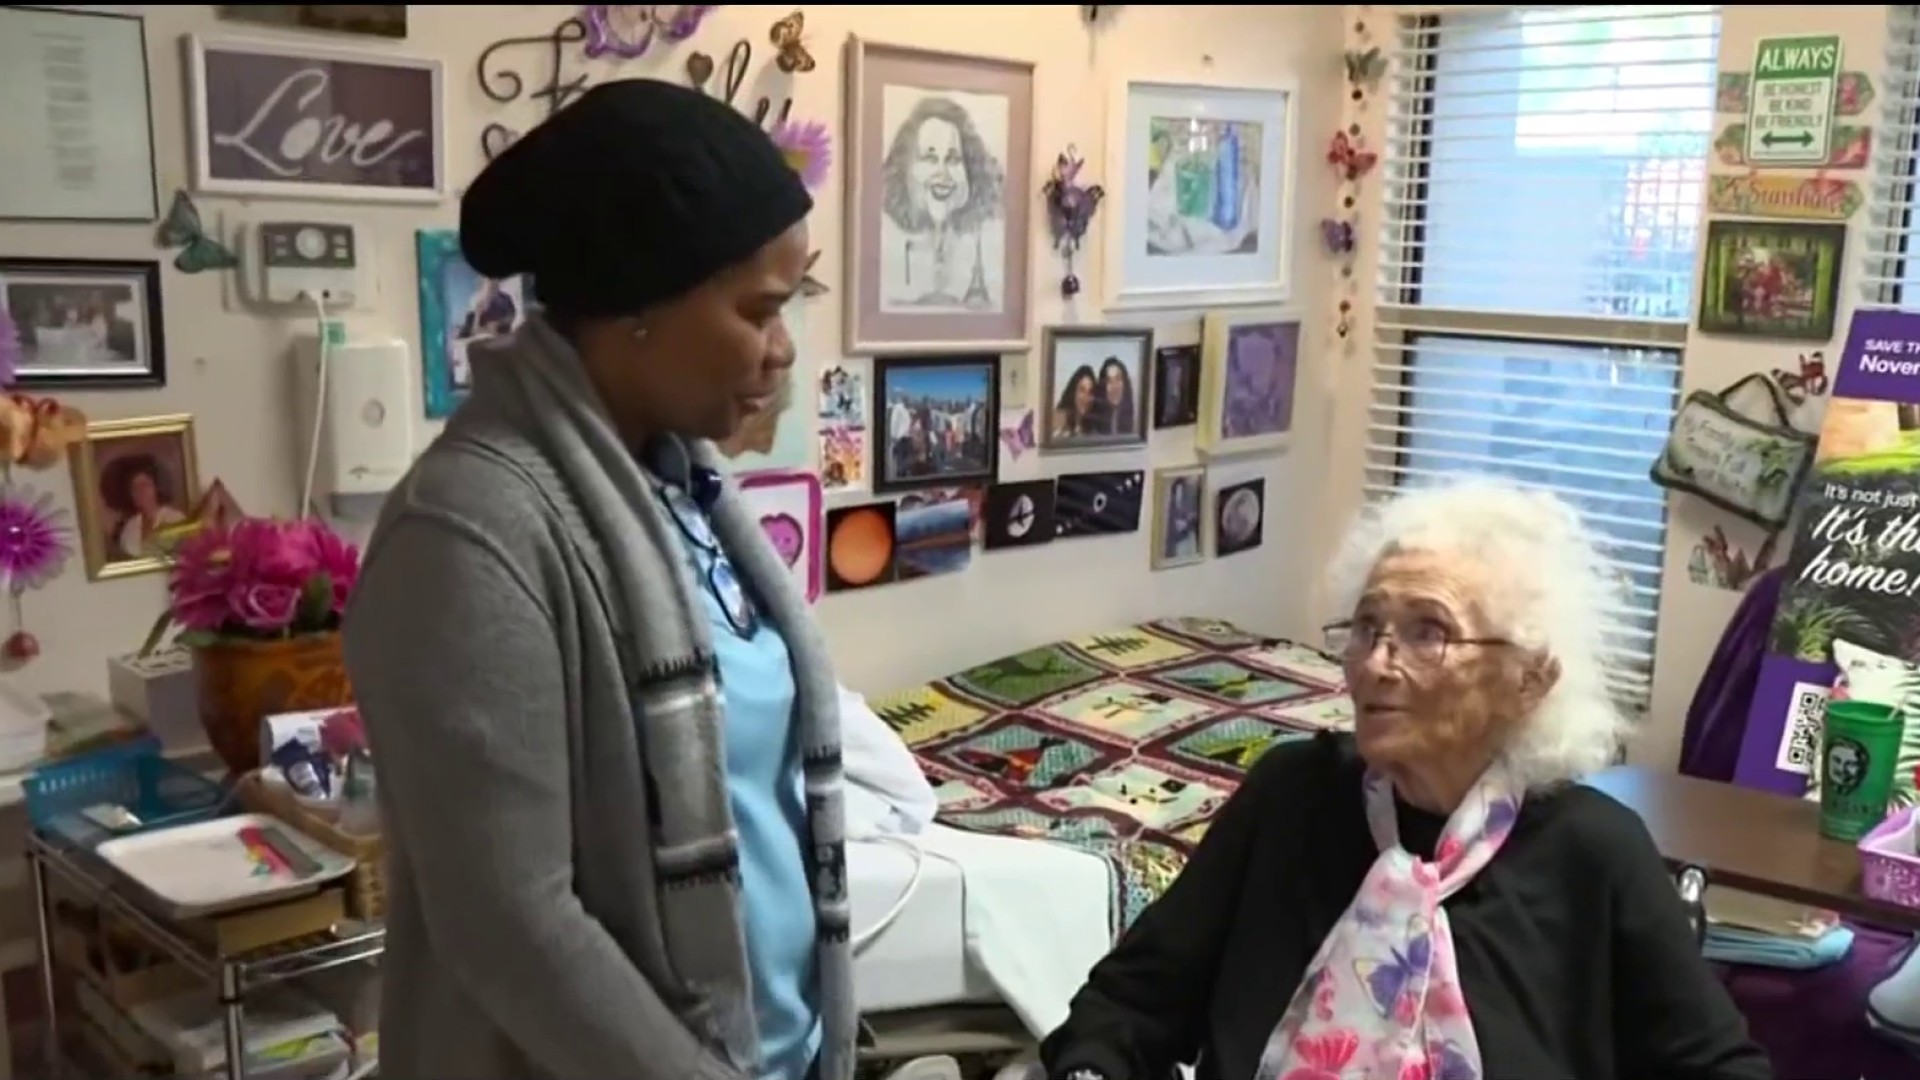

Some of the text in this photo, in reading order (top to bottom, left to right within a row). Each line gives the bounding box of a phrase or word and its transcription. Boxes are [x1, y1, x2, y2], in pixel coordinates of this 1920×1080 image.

[1759, 45, 1835, 72] ALWAYS
[213, 68, 425, 177] Love
[1864, 339, 1904, 354] SAVE
[1824, 483, 1920, 509] It's not just
[1811, 504, 1869, 545] It's
